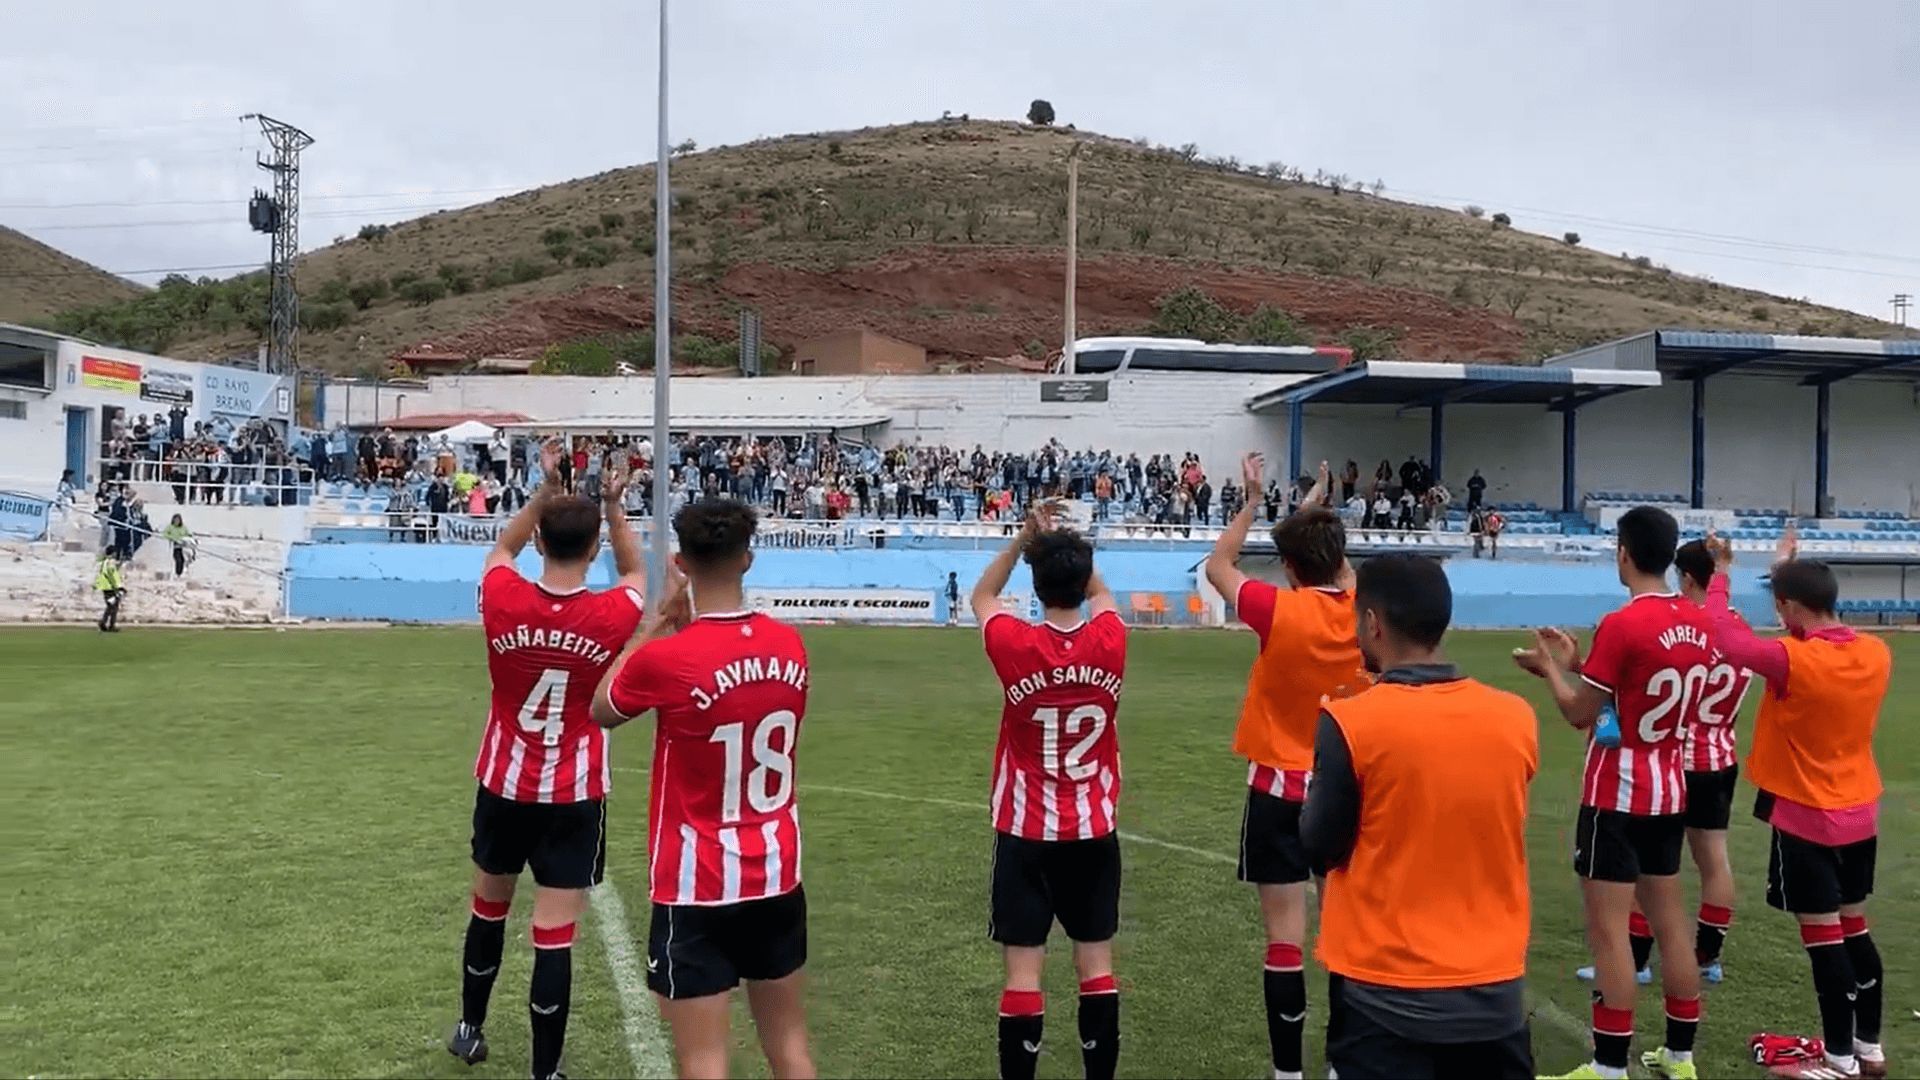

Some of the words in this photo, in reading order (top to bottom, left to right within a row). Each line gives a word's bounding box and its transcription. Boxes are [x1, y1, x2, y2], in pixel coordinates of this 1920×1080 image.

[225, 379, 249, 393] RAYO
[446, 519, 503, 541] Nuest
[772, 598, 849, 608] TALLERES
[852, 598, 930, 609] ESCOLANO
[492, 624, 611, 666] DUÑABEITIA
[1658, 625, 1708, 650] VARELA
[517, 668, 570, 746] 4
[1638, 664, 1709, 744] 20
[1698, 663, 1753, 725] 27
[709, 709, 797, 823] 18
[1032, 704, 1107, 781] 12
